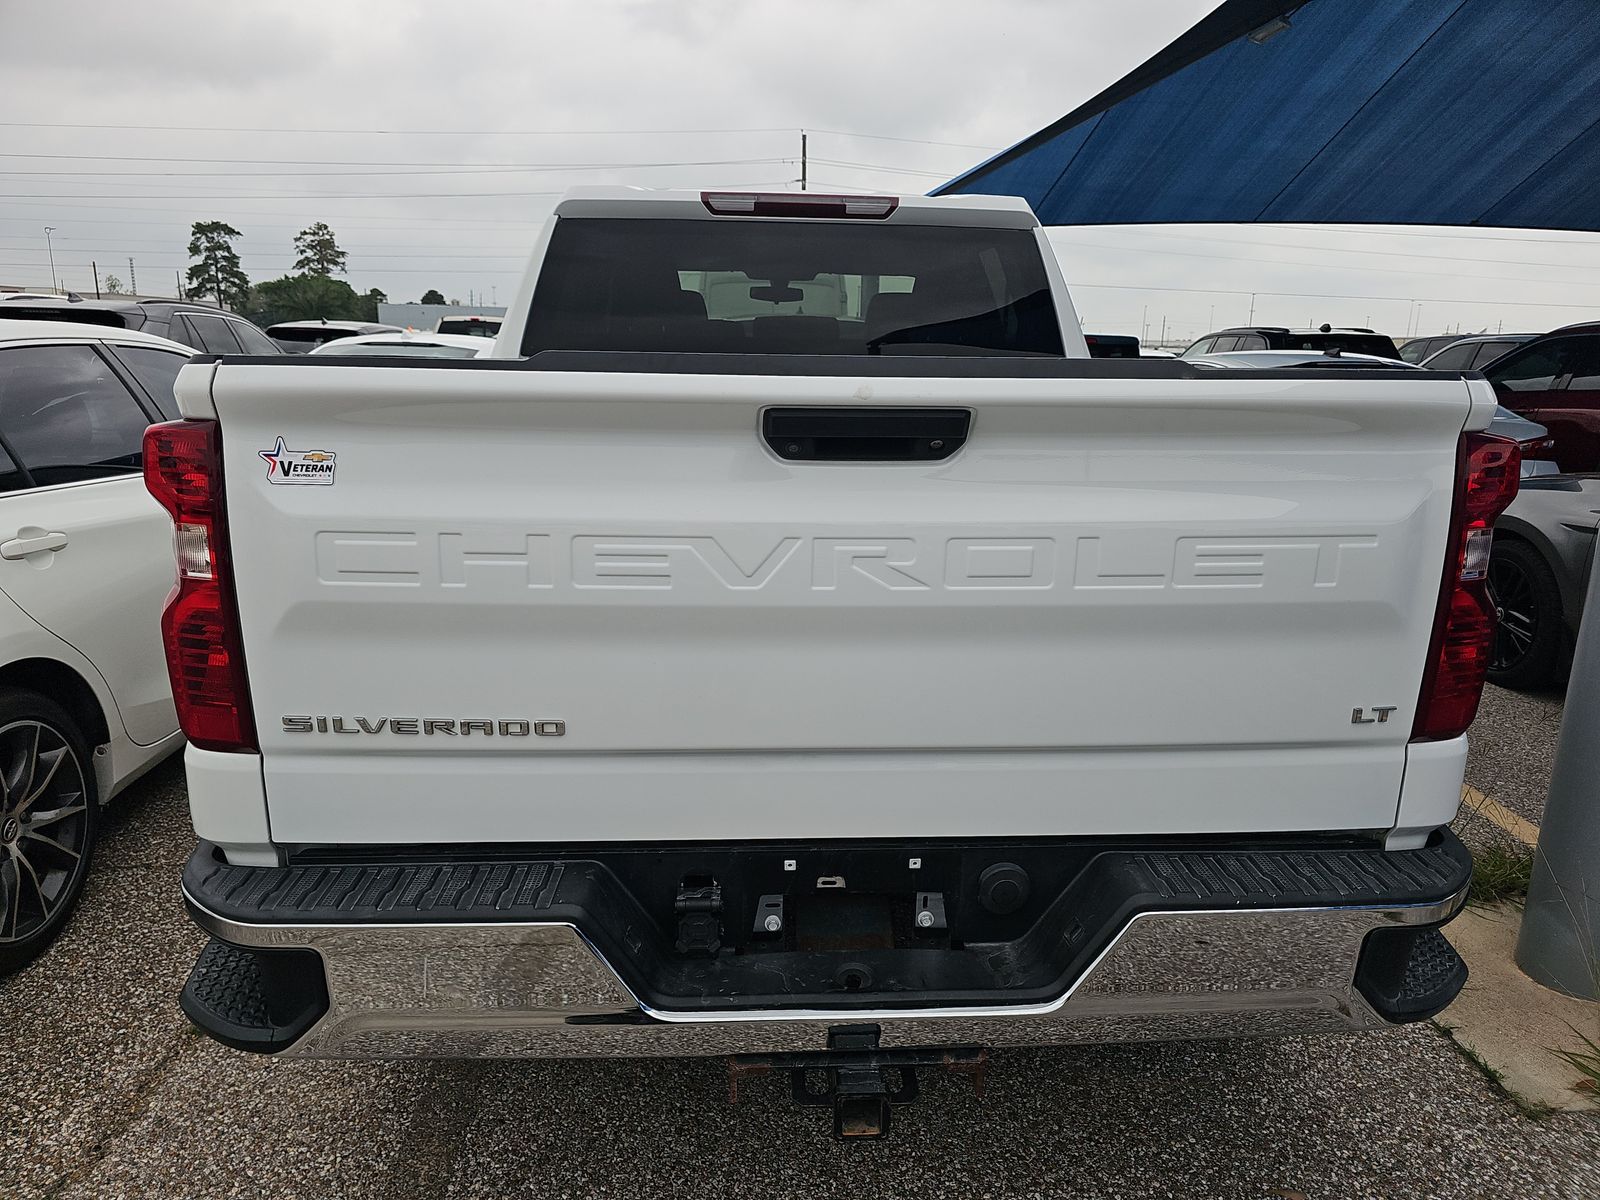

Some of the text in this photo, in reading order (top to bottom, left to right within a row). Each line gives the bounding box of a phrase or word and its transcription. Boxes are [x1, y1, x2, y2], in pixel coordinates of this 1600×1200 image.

[279, 460, 333, 477] VETERAN
[314, 530, 1379, 591] CHEVROLET
[1351, 705, 1398, 724] LT
[282, 714, 566, 737] SILVERADO
